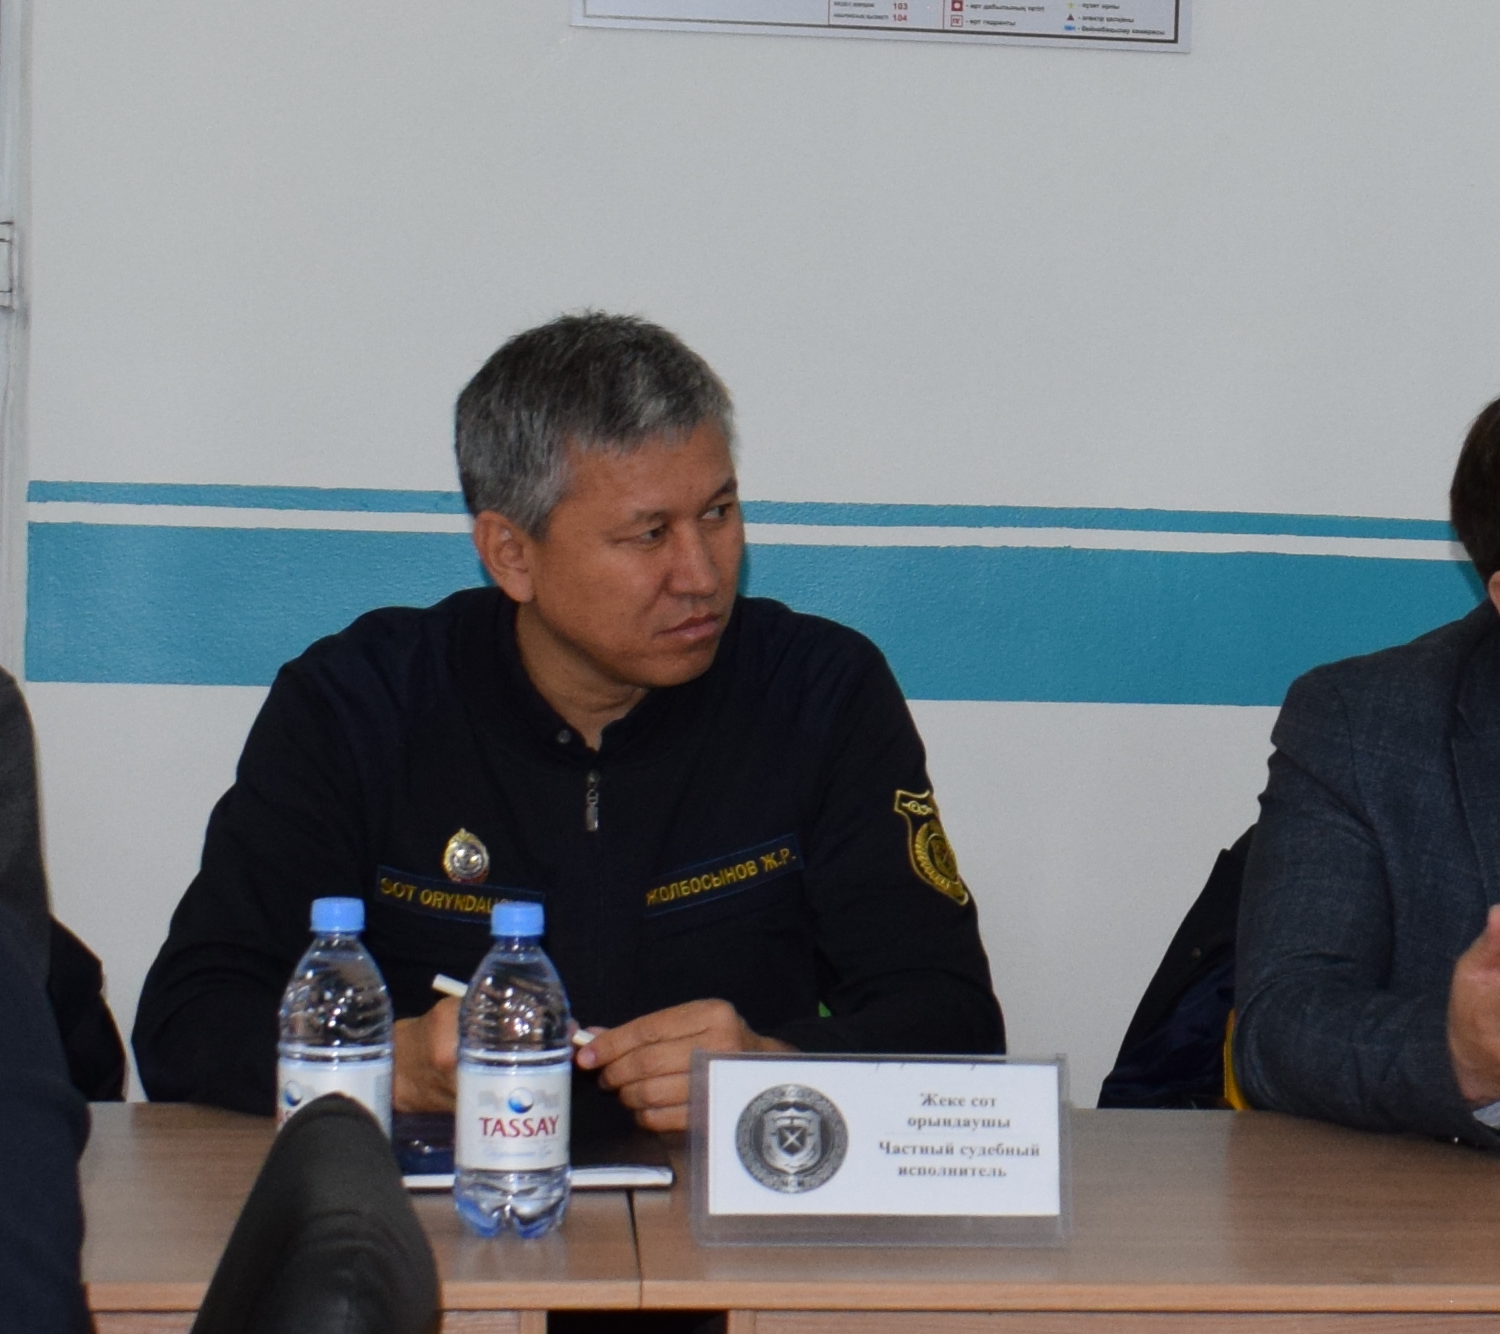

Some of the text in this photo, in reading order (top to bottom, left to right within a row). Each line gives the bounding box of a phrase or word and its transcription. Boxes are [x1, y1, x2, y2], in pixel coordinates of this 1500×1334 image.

[893, 2, 908, 10] 103
[892, 14, 908, 22] 104
[644, 859, 759, 907] ЖОЛБОСЫНОВ
[380, 877, 512, 915] SOT ORYNDAU
[920, 1092, 998, 1108] Жеке сот
[478, 1114, 560, 1139] TASSAY
[907, 1116, 1011, 1131] орындаушы
[878, 1140, 1041, 1160] Частный судебный
[897, 1164, 1007, 1178] исполнитель
